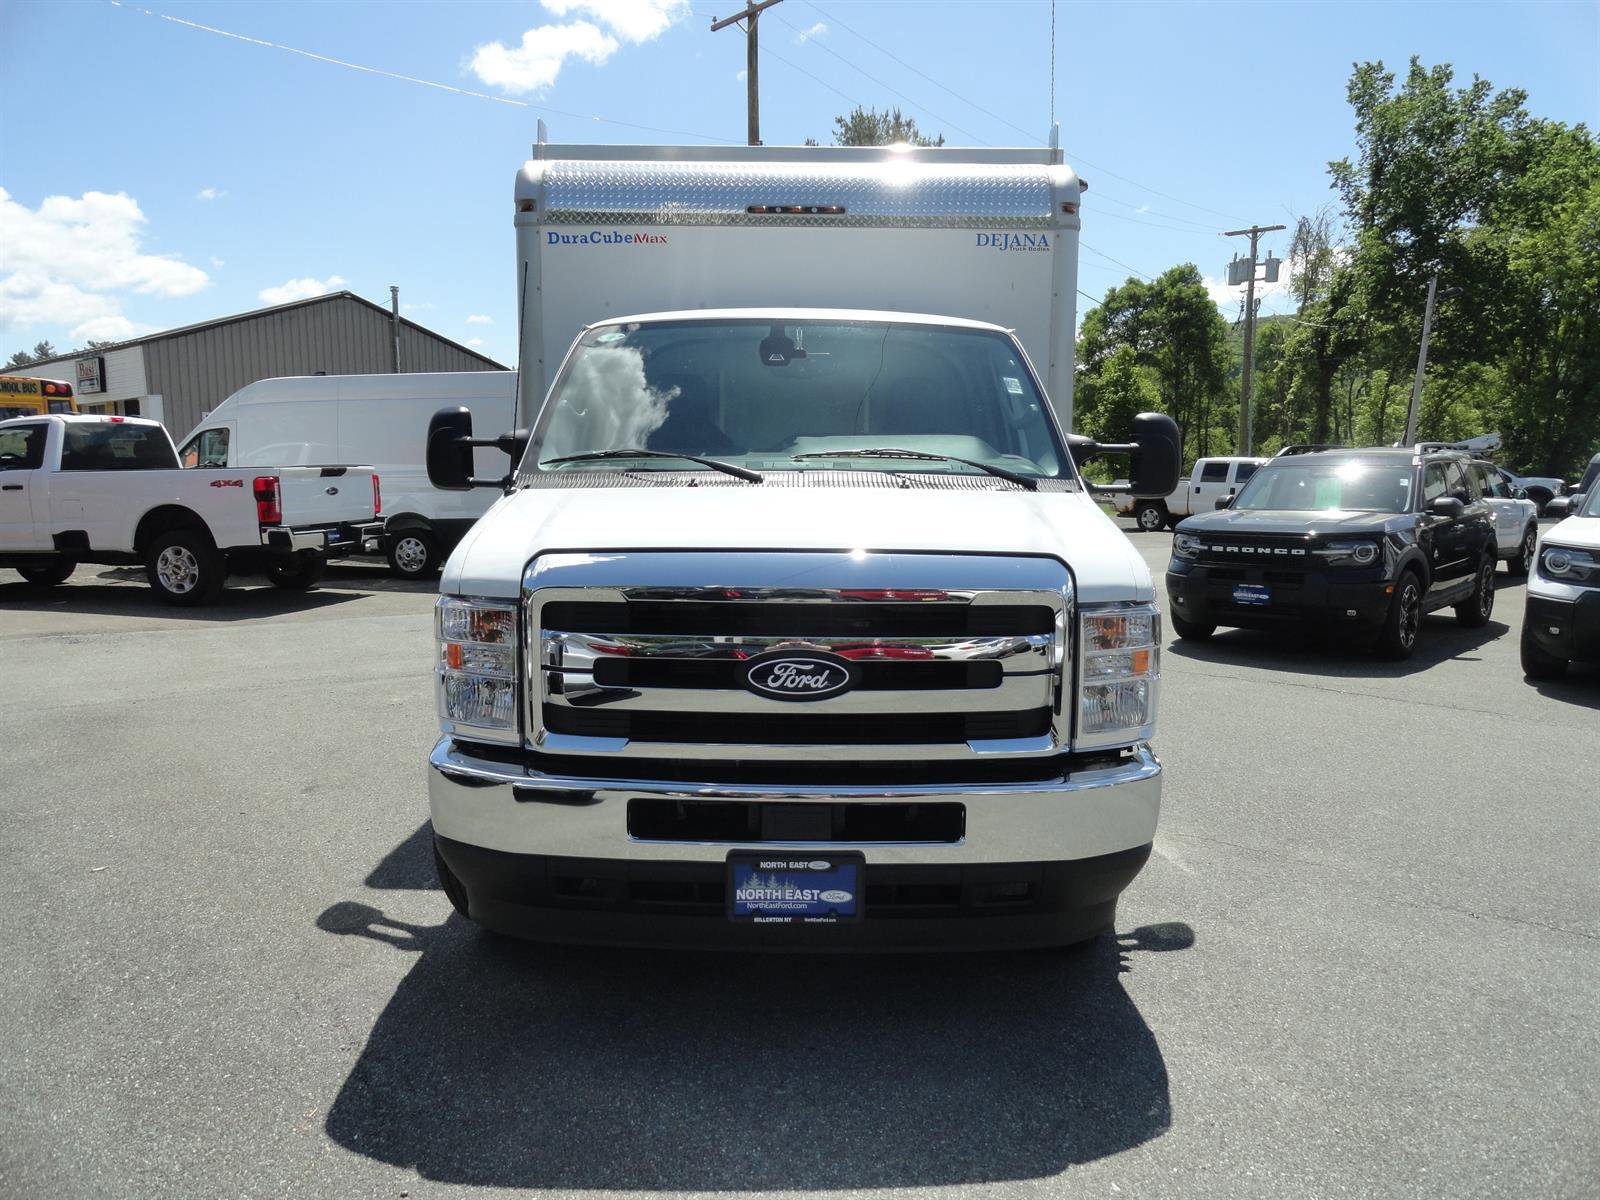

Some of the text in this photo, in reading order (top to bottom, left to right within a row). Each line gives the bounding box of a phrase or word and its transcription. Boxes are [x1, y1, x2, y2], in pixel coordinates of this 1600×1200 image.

[547, 231, 667, 244] DuraCubeMax
[976, 233, 1048, 250] DEJANA
[23, 382, 37, 393] BUS
[1211, 545, 1305, 555] BRONCO
[767, 663, 830, 688] Ford
[760, 861, 786, 869] NORTH
[789, 861, 808, 869] EAST
[736, 889, 820, 900] NORTH EAST
